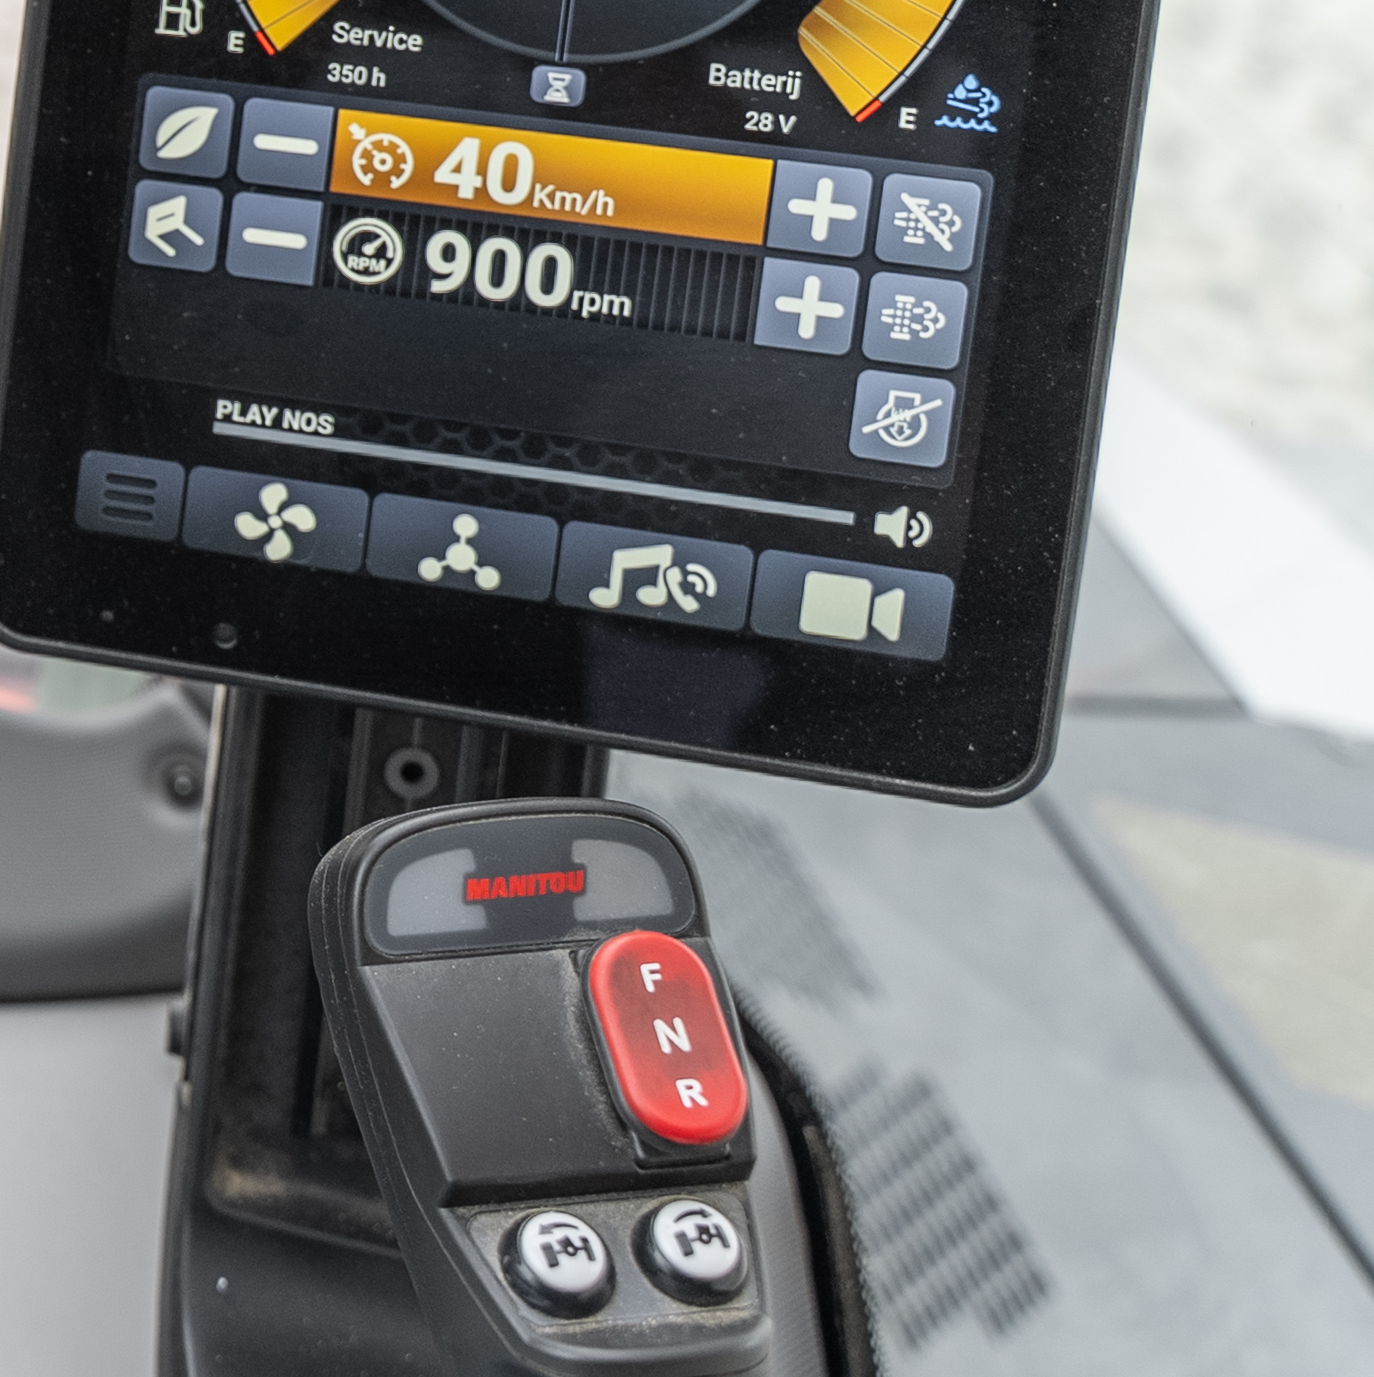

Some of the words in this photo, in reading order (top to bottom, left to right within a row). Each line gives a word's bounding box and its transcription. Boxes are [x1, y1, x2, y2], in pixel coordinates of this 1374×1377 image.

[226, 30, 245, 54] E
[331, 21, 423, 52] Service
[326, 62, 369, 86] 350
[371, 66, 387, 88] h
[707, 62, 802, 100] Batterij
[744, 110, 773, 133] 28
[778, 113, 798, 135] V
[898, 107, 919, 130] E
[433, 135, 535, 206] 40
[533, 182, 616, 218] Km/h
[346, 254, 388, 275] RPM
[424, 228, 575, 308] 900
[570, 285, 633, 320] rpm
[214, 398, 279, 428] PLAY
[281, 408, 335, 435] NOS
[466, 871, 584, 900] MANITOU
[640, 962, 662, 992] F
[653, 1017, 691, 1053] N
[675, 1078, 707, 1108] R
